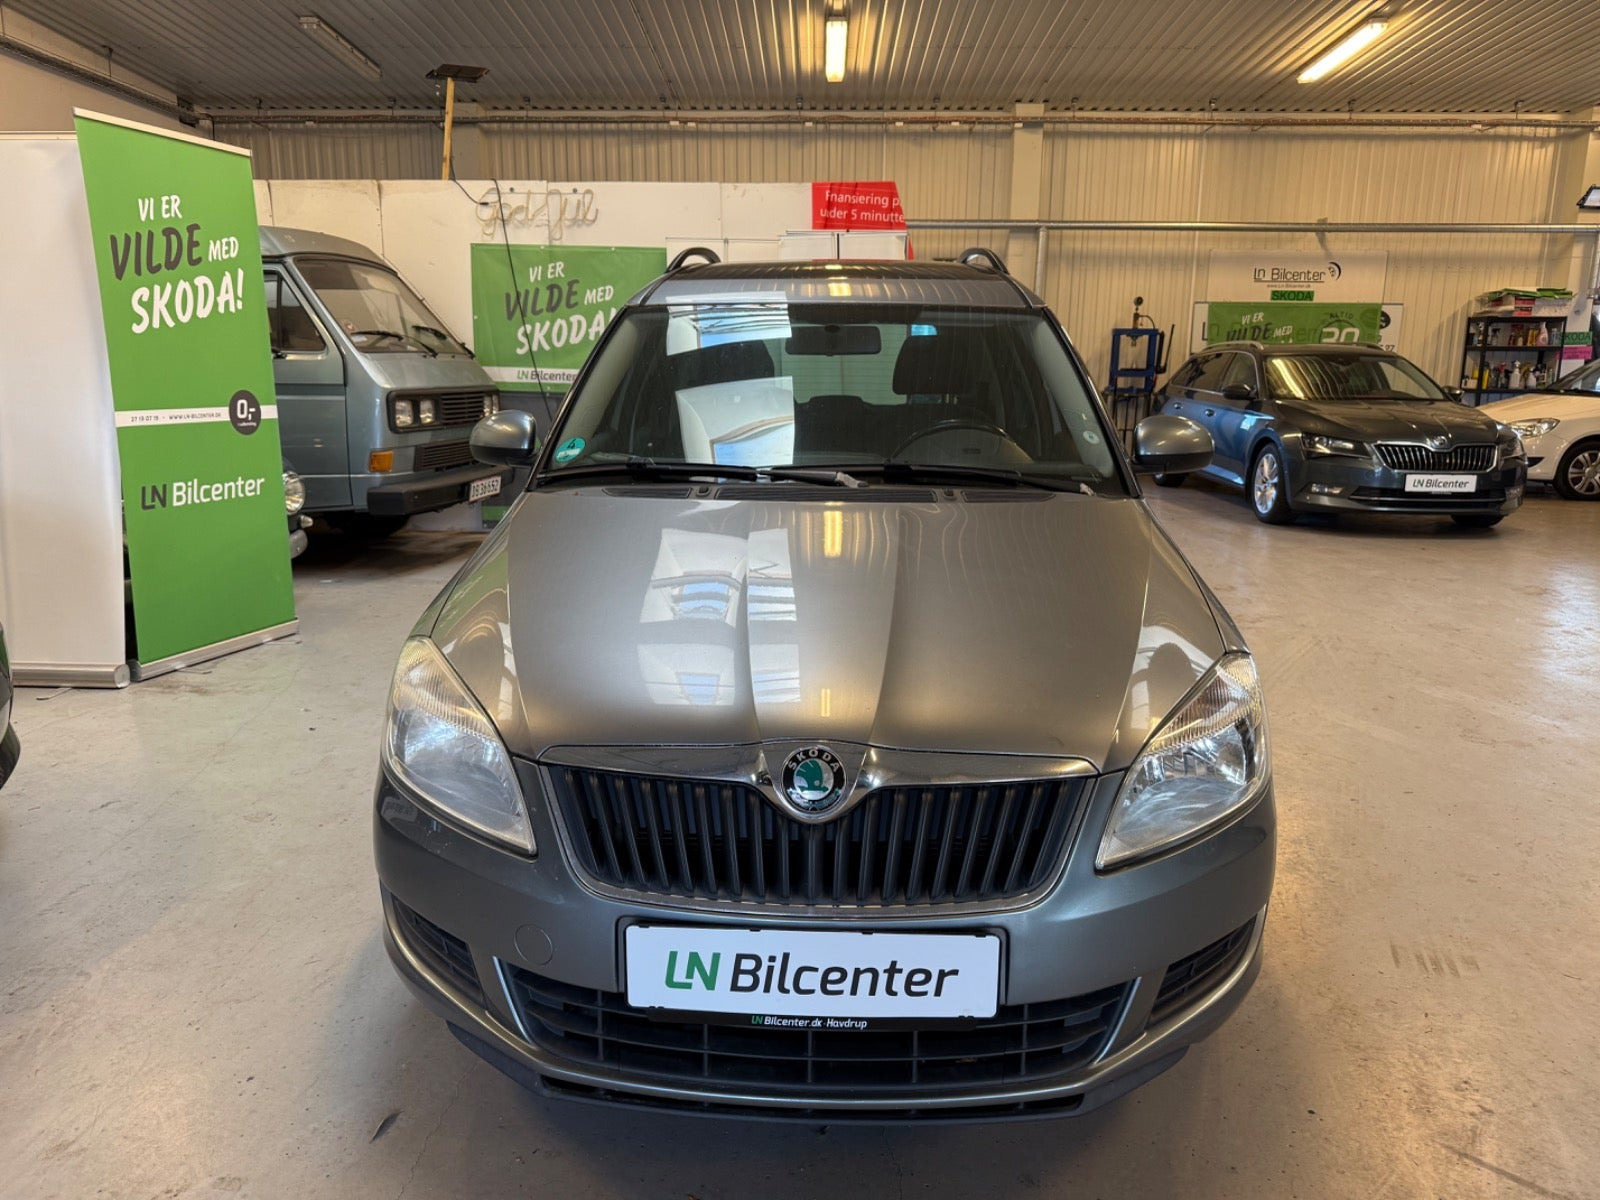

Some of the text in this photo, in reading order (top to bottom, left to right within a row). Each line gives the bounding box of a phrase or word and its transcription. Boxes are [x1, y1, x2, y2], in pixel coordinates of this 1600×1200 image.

[138, 195, 183, 222] VI ER
[825, 190, 889, 208] Fnansiering
[851, 208, 858, 220] 5
[860, 210, 905, 223] minutte
[109, 223, 239, 281] VILDE MED
[529, 261, 565, 283] VI ER
[1271, 267, 1326, 281] Bilcenter
[131, 267, 244, 334] SKODA!
[505, 278, 614, 321] VILDE MED
[1271, 290, 1314, 301] SKODA
[1253, 311, 1265, 323] ER
[516, 369, 529, 380] LN
[141, 476, 266, 511] LN Bilcenter
[1412, 478, 1469, 489] LN Bilcenter
[788, 748, 840, 773] SKODA
[664, 950, 960, 998] LN Bilcenter
[751, 1015, 868, 1030] LN Bilcenter.dk Havdrup
